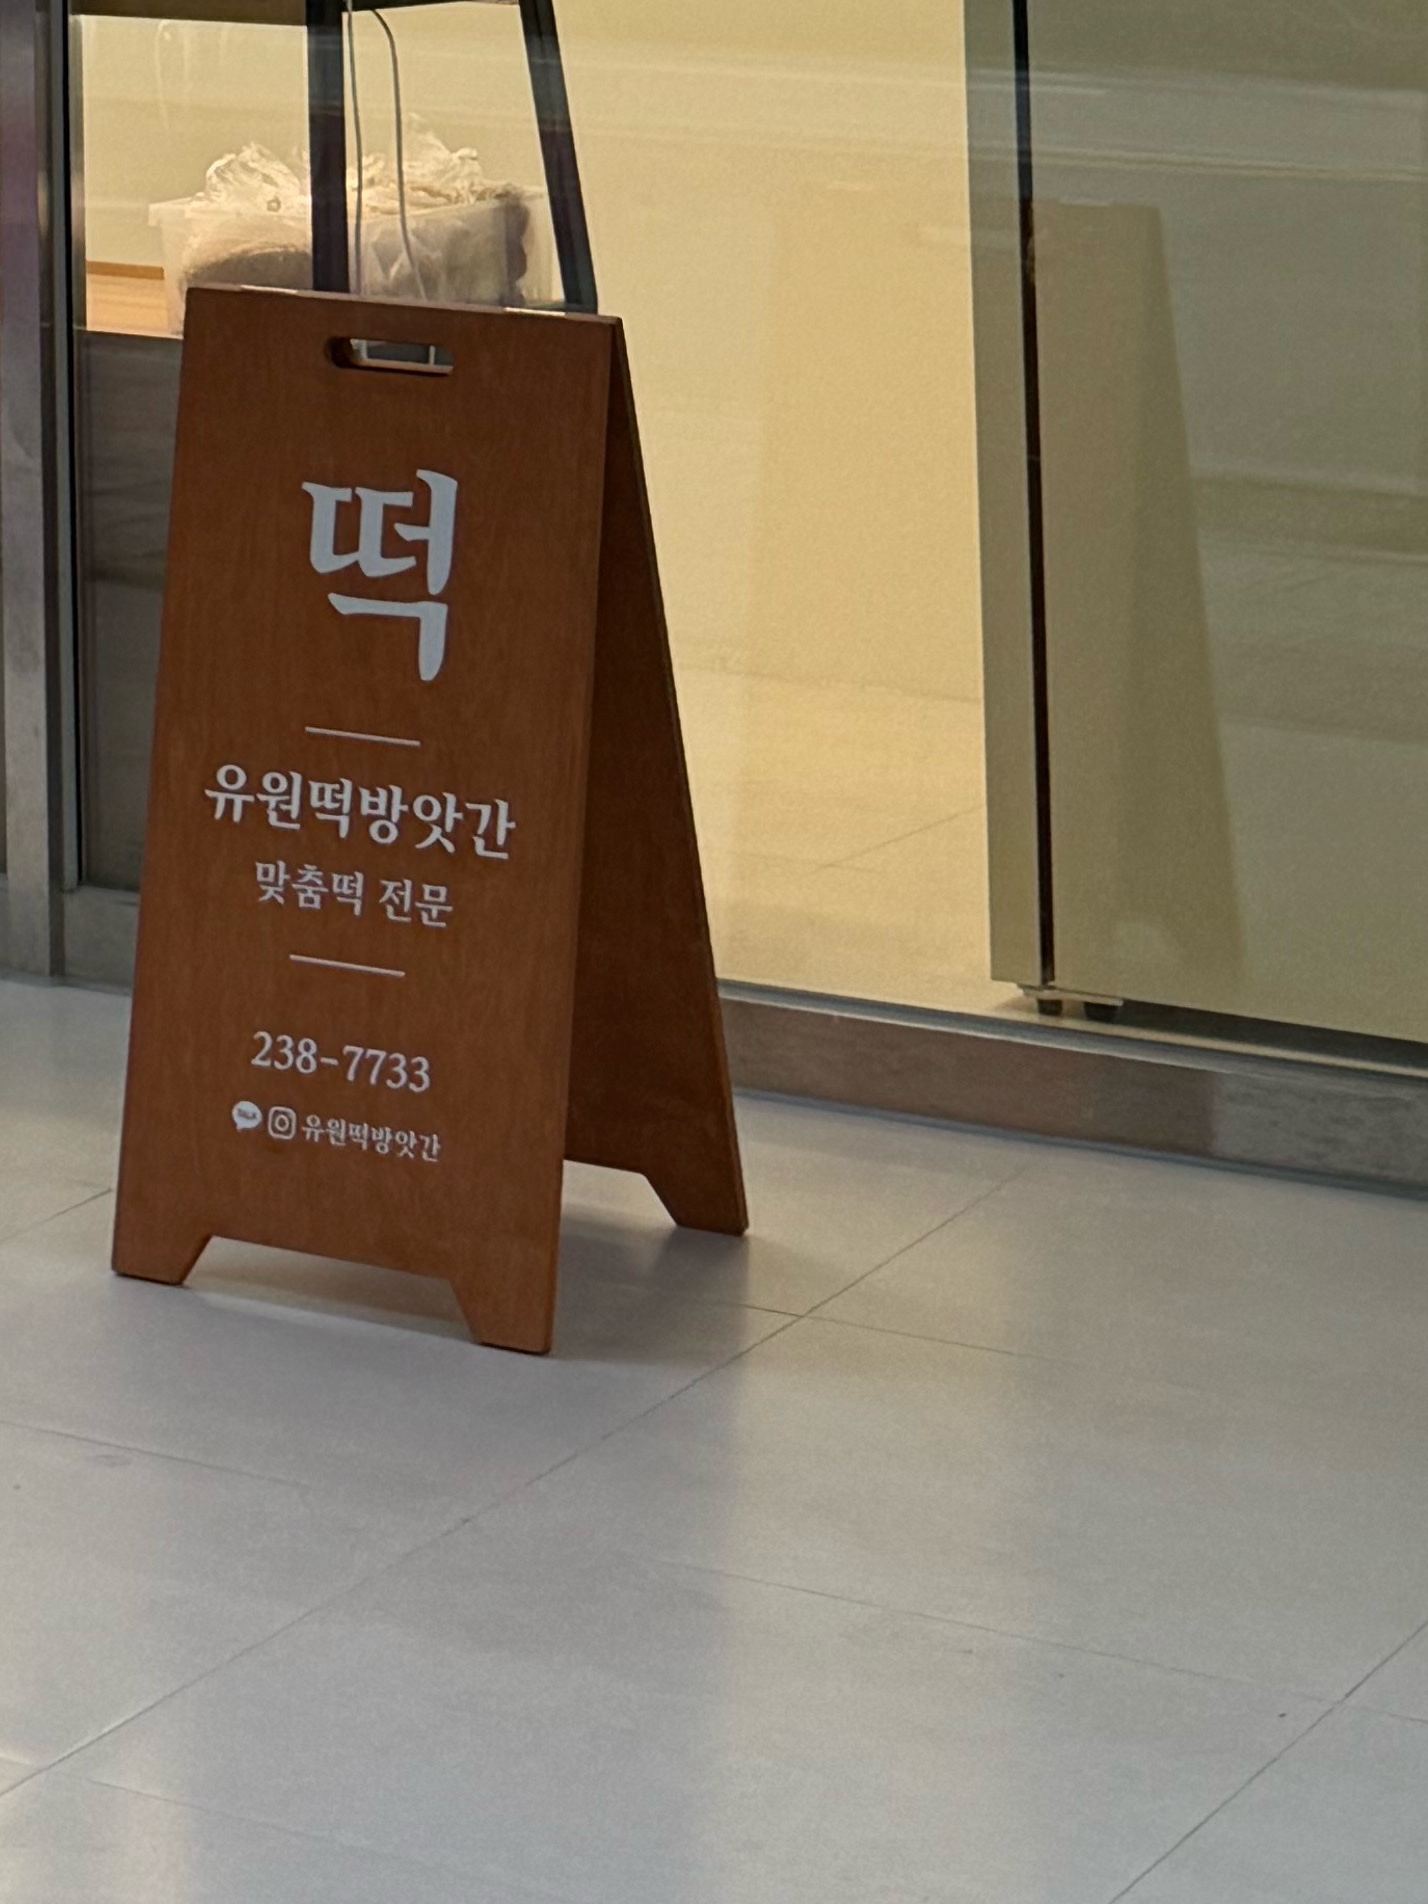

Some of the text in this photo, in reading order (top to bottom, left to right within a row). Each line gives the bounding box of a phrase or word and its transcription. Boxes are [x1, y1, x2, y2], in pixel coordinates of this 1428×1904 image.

[302, 469, 460, 682] 떡
[204, 764, 517, 860] 유원떡방앗간
[255, 860, 454, 928] 맞춤떡 전문
[251, 1030, 431, 1093] 238-7733
[301, 1114, 442, 1163] 유원떡방앗간
